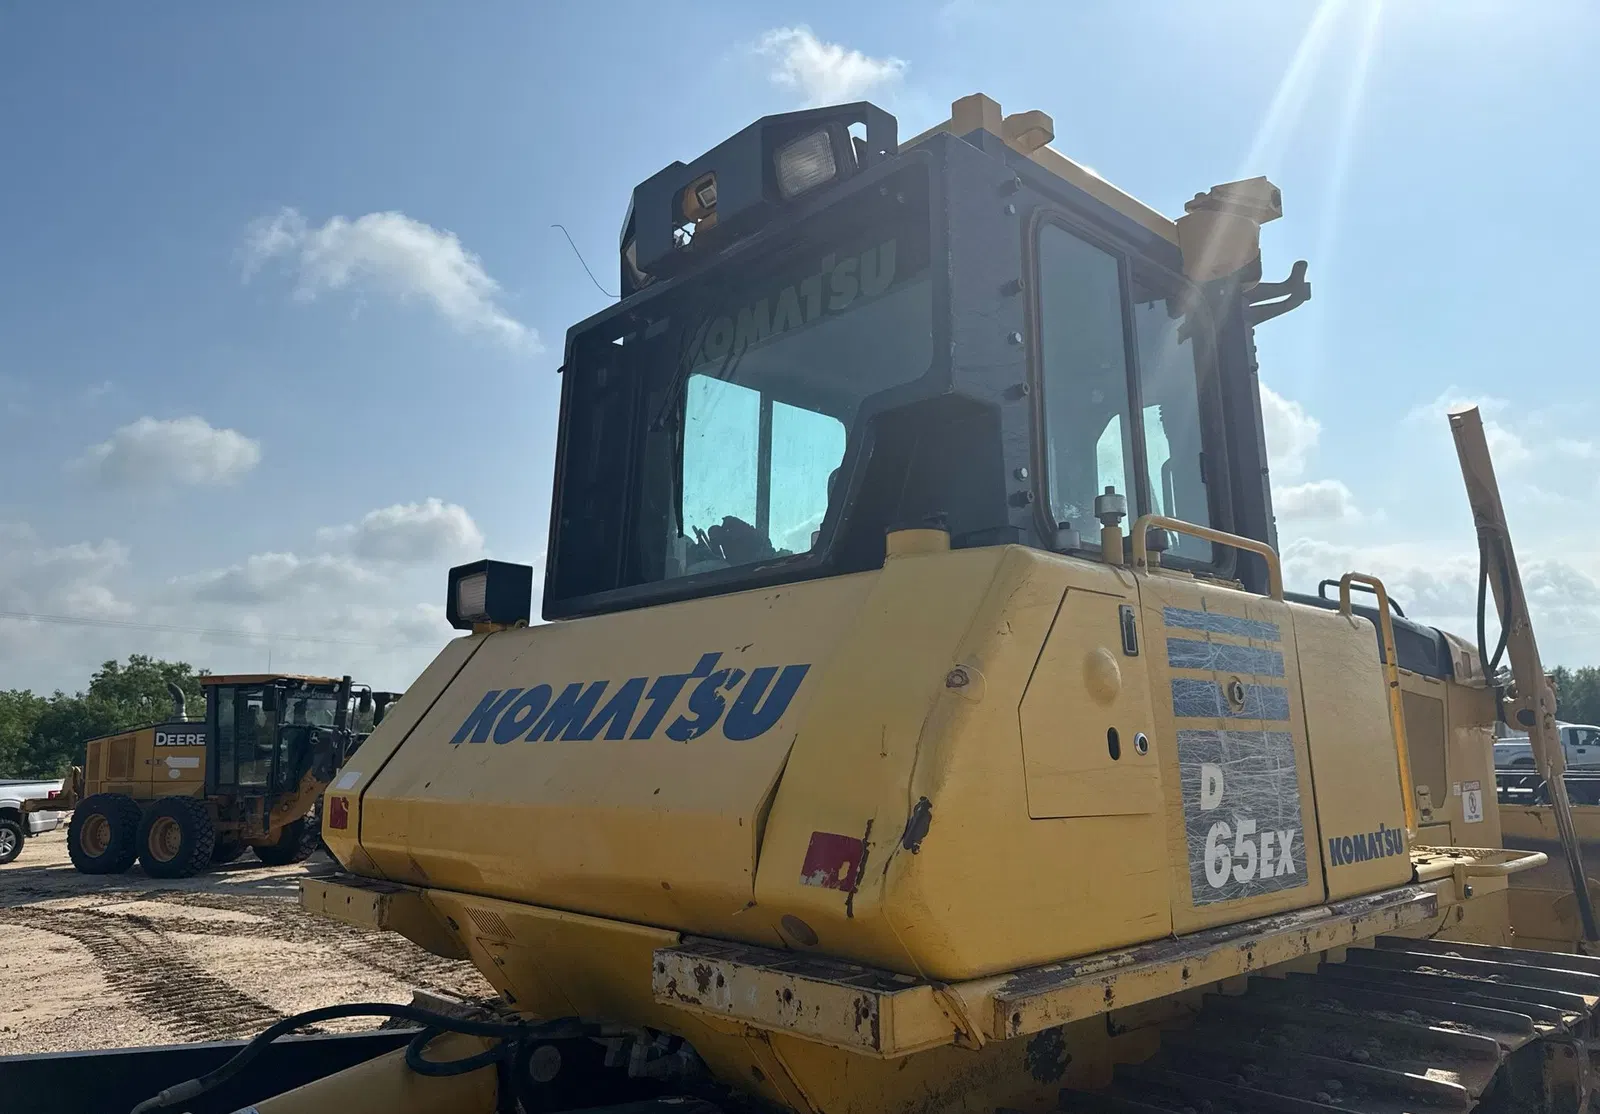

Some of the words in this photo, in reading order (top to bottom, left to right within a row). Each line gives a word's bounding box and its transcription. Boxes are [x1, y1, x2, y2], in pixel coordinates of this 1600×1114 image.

[449, 652, 812, 744] KOMATSU
[155, 732, 206, 746] DEERE
[1201, 763, 1224, 810] D
[1204, 819, 1296, 889] 65EX
[1328, 822, 1403, 867] KOMATSU
